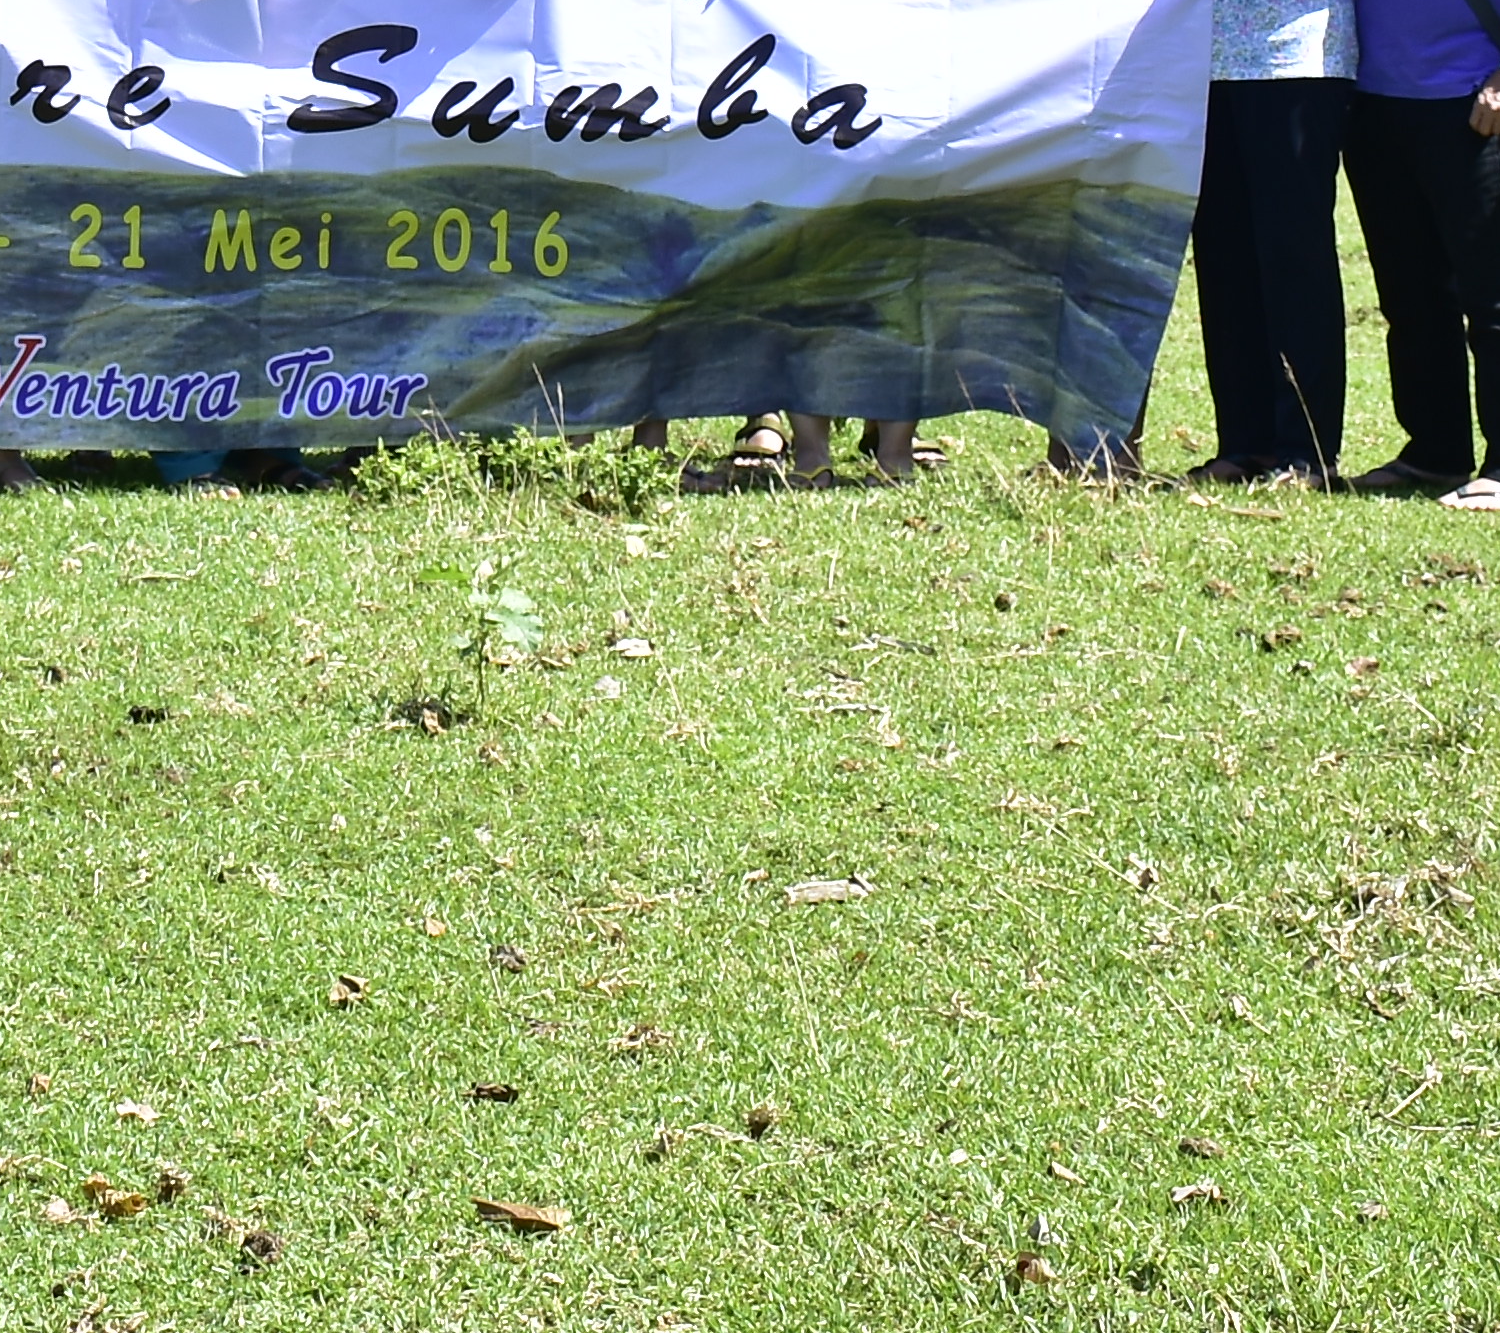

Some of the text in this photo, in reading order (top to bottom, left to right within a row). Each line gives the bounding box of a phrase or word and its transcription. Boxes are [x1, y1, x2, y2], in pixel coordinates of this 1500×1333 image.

[287, 24, 883, 150] Sumba
[69, 203, 146, 269] 21
[204, 209, 332, 274] Mei
[386, 209, 569, 277] 2016
[267, 347, 429, 419] Tour
